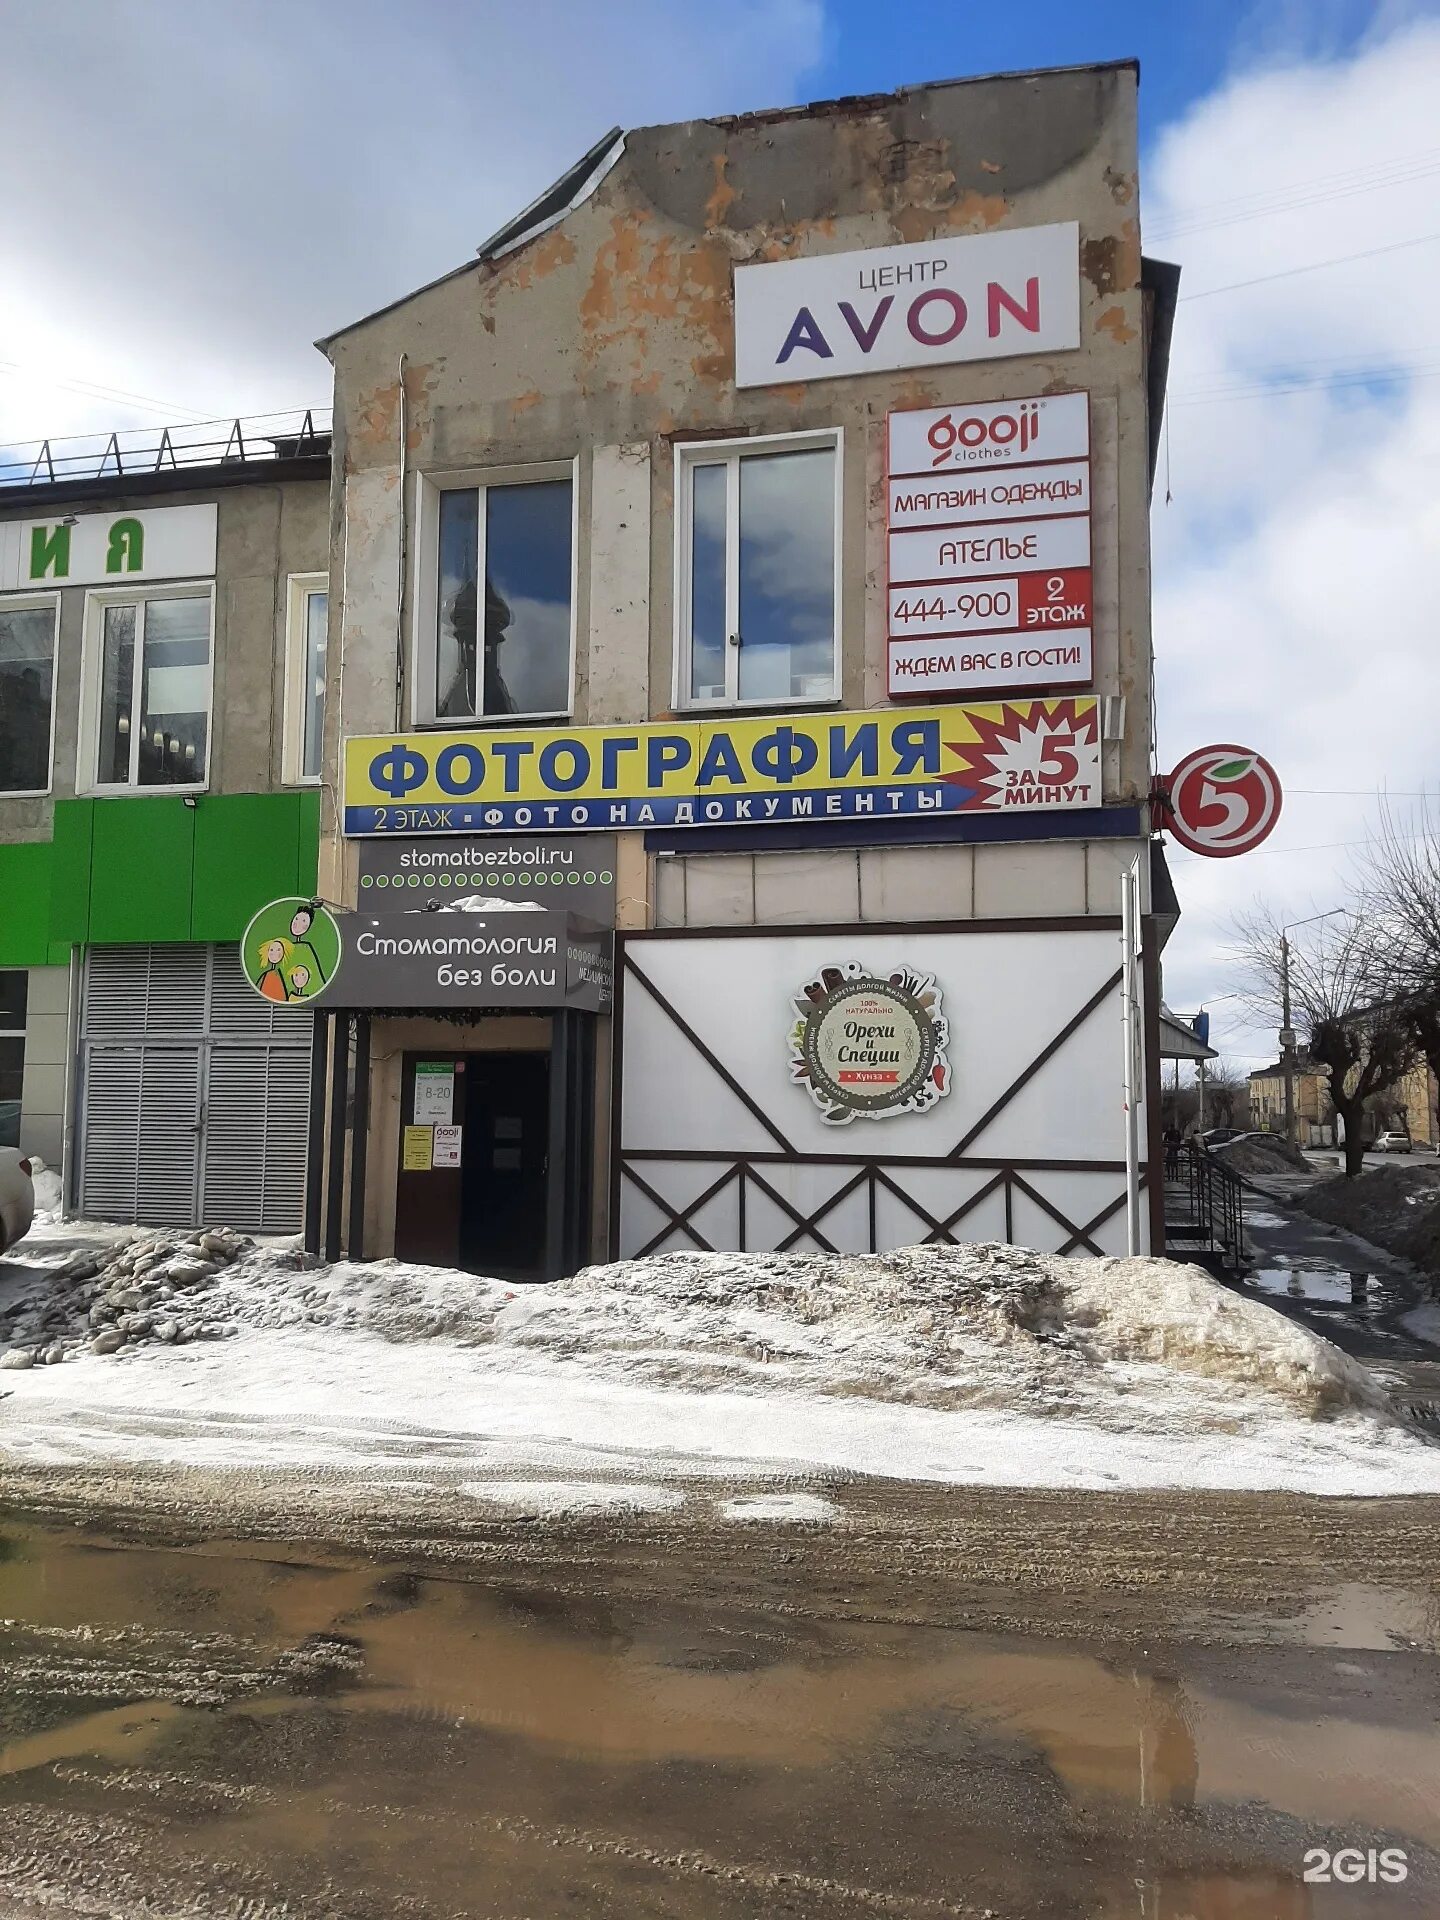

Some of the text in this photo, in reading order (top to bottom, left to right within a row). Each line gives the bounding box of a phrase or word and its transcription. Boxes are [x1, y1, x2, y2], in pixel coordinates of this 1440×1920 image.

[859, 259, 948, 292] ЦЕНТР
[775, 276, 1041, 365] AVON
[927, 403, 1039, 467] gooji
[954, 447, 1012, 462] clothes
[894, 478, 1083, 512] МАГАЗИН ОДЕЖДЫ
[939, 534, 1038, 566] АТЕЛЬЕ
[1046, 576, 1065, 601] 2
[893, 591, 1011, 624] 444-900
[895, 646, 1081, 677] ЖДЕМ ВАС В ГОСТИ!
[368, 718, 942, 798] ФОТОГРАФИЯ
[1005, 734, 1079, 787] ЗА 5
[1004, 785, 1092, 806] МИНУТ
[374, 789, 943, 829] 2 ЭТАЖ ФОТО НА ДОКУМЕНТЫ
[399, 846, 574, 867] stomatbezboli.ru
[356, 932, 557, 957] Стоматология
[436, 962, 557, 987] без боли
[845, 1007, 894, 1015] НАТУРАЛЬНО
[860, 999, 879, 1007] 100%
[843, 1021, 896, 1043] Орехи
[837, 1045, 900, 1067] Специи
[865, 1040, 874, 1050] и
[855, 1071, 883, 1082] Хунза
[425, 1086, 451, 1099] 8-20
